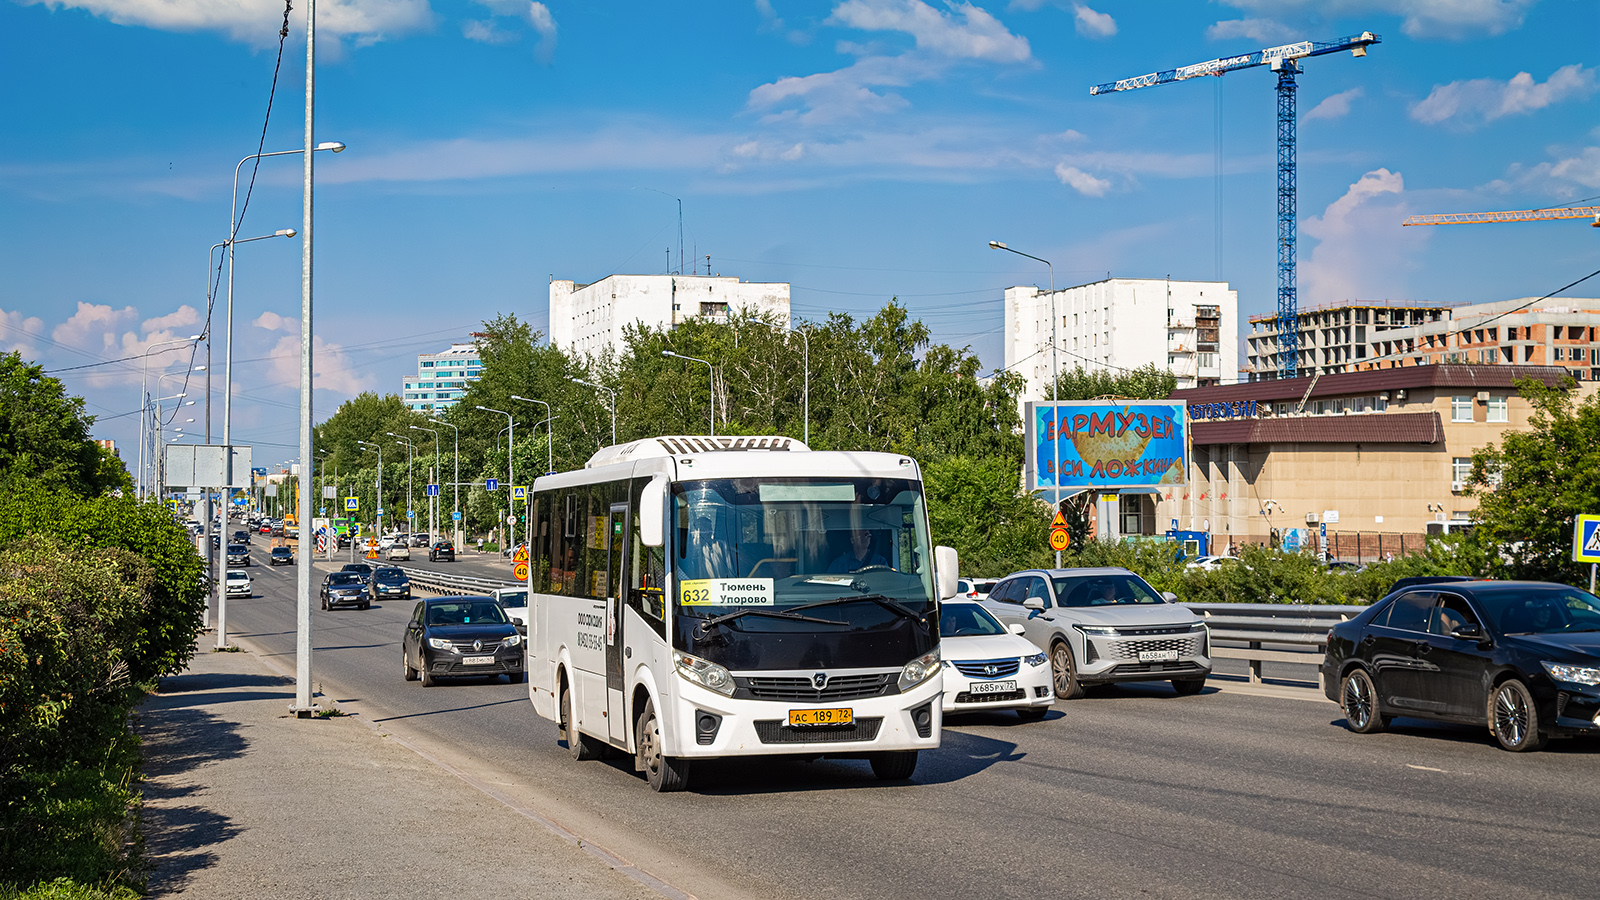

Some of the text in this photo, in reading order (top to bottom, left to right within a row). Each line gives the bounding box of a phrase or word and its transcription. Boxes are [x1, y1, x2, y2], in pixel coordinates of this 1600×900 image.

[1186, 55, 1251, 74] БРУСНИКА
[1054, 534, 1065, 544] 40
[516, 567, 528, 576] 40
[683, 582, 766, 603] 632 Тюмень
[720, 595, 767, 605] Упорово
[794, 709, 849, 722] АС 189 72
